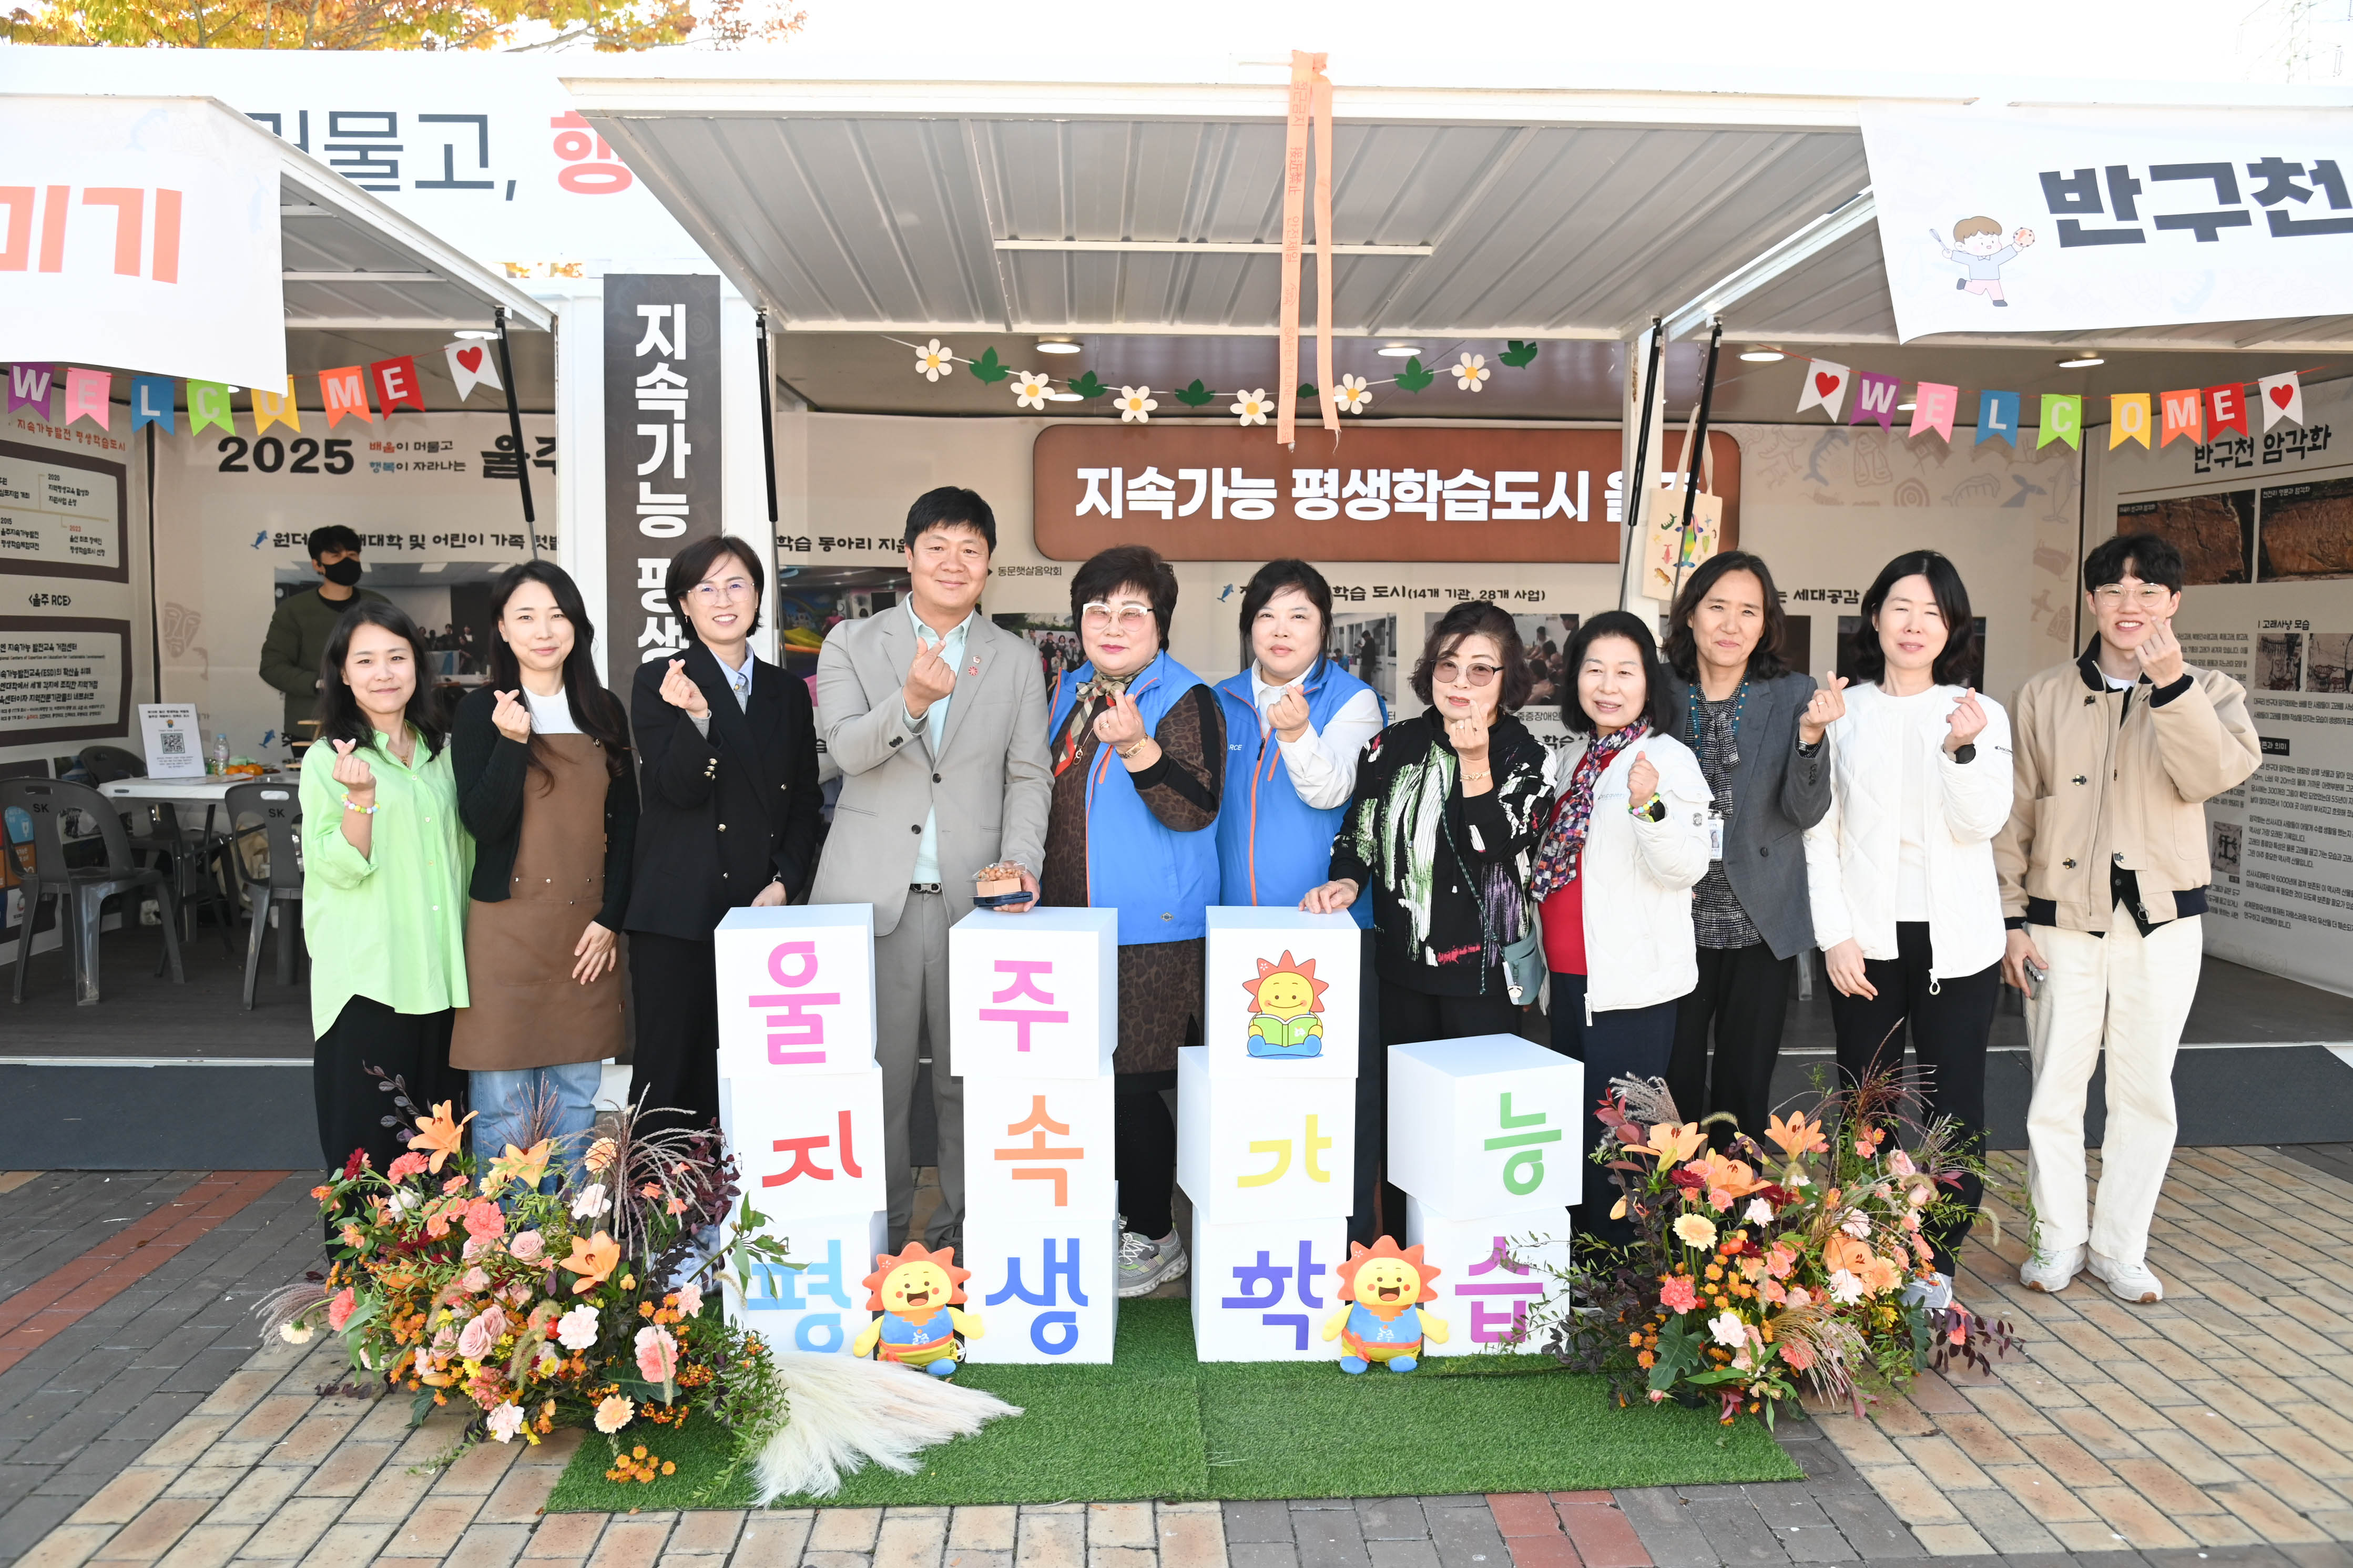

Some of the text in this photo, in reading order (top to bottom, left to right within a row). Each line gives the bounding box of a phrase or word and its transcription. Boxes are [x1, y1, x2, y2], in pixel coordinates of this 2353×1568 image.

[1288, 147, 1303, 196] 接近禁止
[2039, 157, 2353, 248] 반구천
[1286, 216, 1300, 263] 안전제일
[1283, 326, 1295, 400] SAFETY LINE
[1861, 379, 2235, 433] WELCOME
[636, 304, 691, 538] 지속가능
[17, 419, 126, 451] 지속가능발전 평생학습도시
[217, 436, 354, 475] 2025
[369, 440, 409, 454] 배움이
[413, 440, 454, 454] 머물고
[2195, 424, 2332, 473] 반구천 암각화
[370, 460, 466, 474] 행복이 자라나는
[1075, 466, 1277, 520] 지속가능
[1291, 467, 1588, 521] 평생학습도시
[1, 528, 39, 539] 울주지속가능발전
[410, 533, 425, 550] 및
[433, 532, 484, 549] 어린이
[491, 533, 525, 550] 가족
[818, 537, 872, 552] 동아리
[998, 566, 1062, 577] 동문햇살음악회
[28, 593, 72, 607] <울주 RCE>
[1333, 586, 1366, 601] 학습
[1445, 589, 1474, 601] 기관,
[1480, 589, 1509, 599] 28개
[1514, 589, 1545, 601] 사업)
[1794, 588, 1860, 604] 세대공감
[2263, 619, 2309, 631] 고래사냥 모습
[8, 643, 77, 652] 지속가능 발전교육 거점센터
[33, 804, 49, 813] SK
[268, 808, 285, 818] SK
